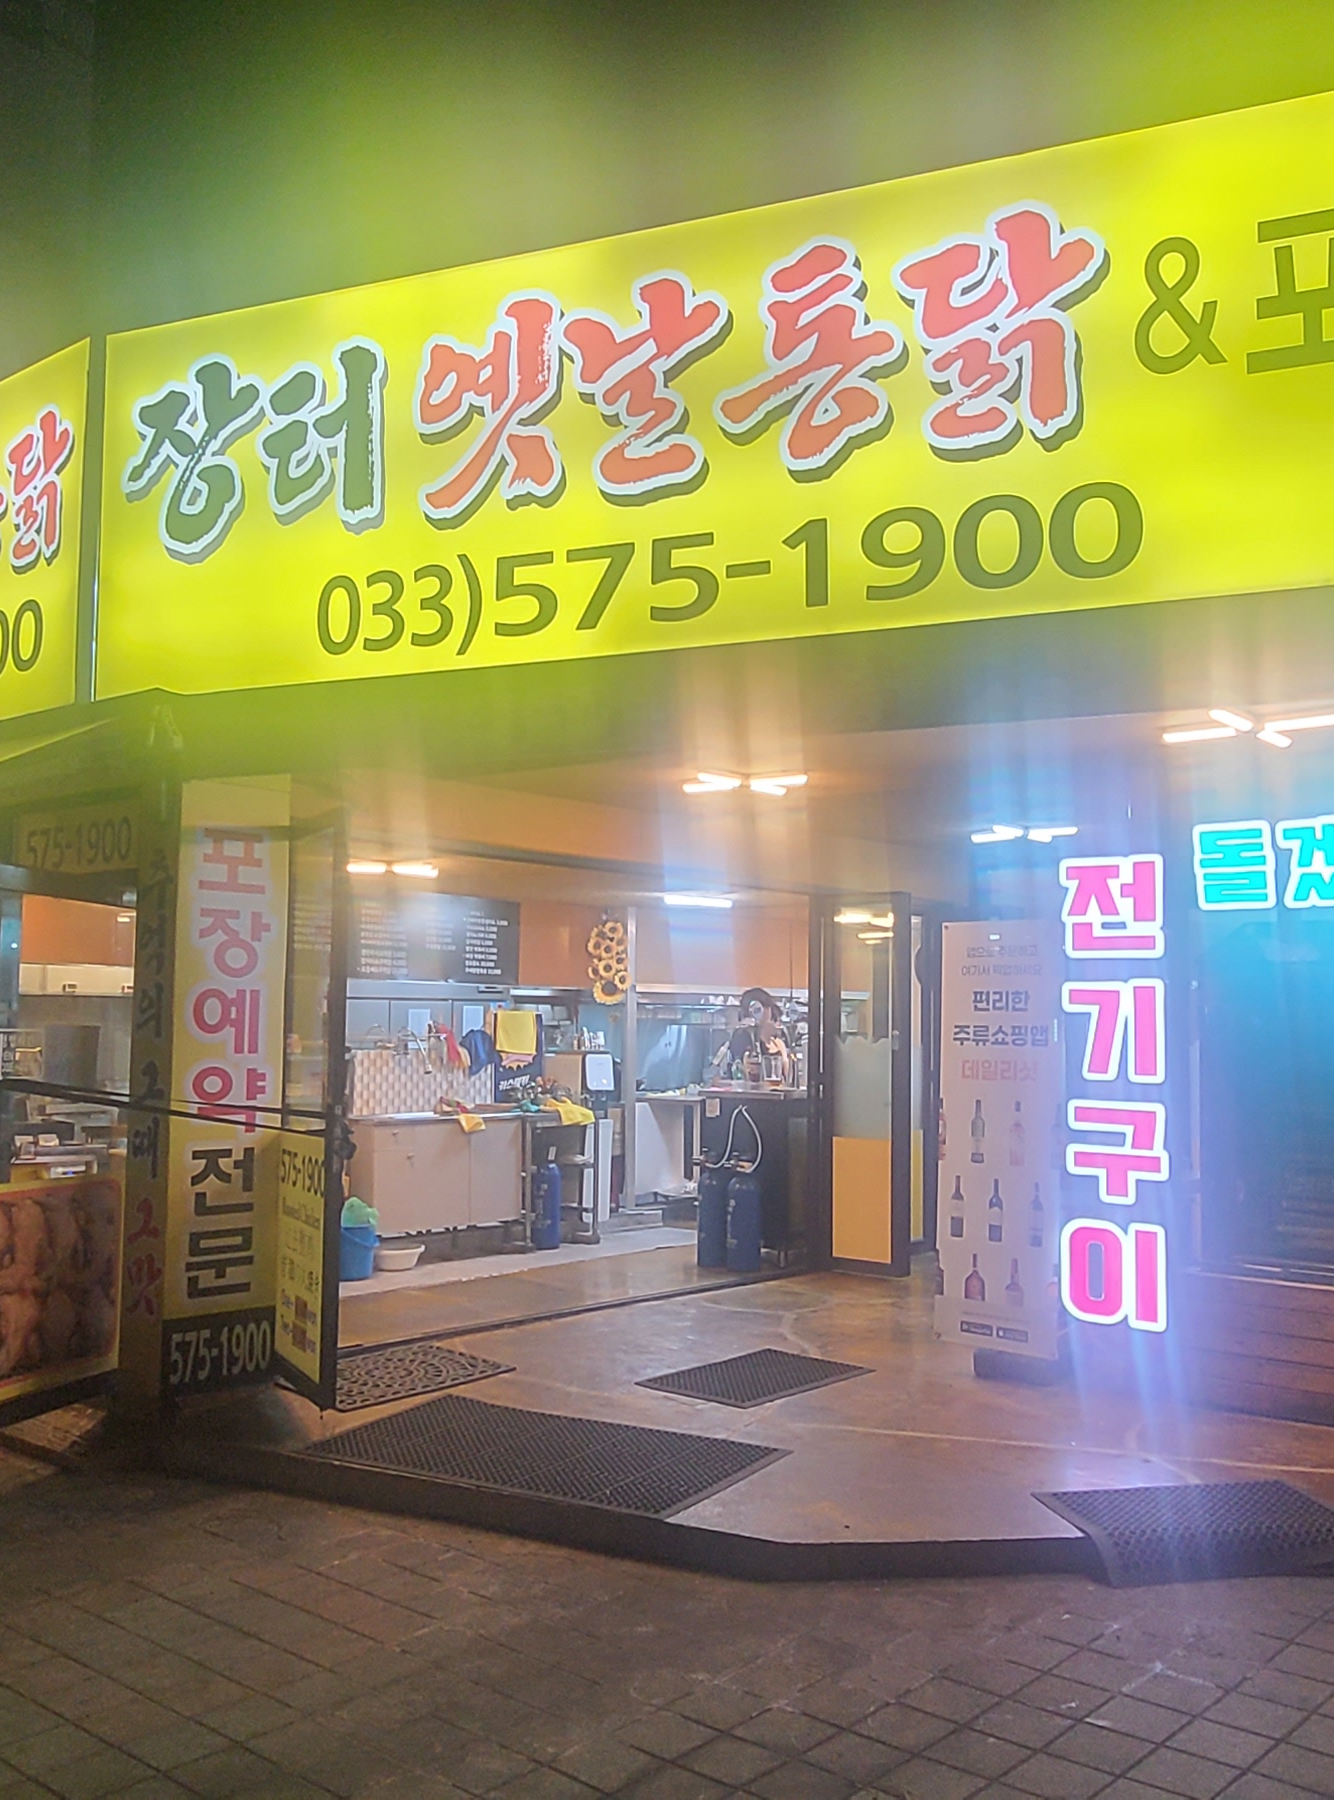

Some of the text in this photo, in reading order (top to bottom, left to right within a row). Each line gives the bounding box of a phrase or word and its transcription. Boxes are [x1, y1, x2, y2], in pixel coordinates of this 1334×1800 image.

[316, 480, 1144, 656] 033)575-1900
[26, 815, 134, 874] 575-1900
[953, 1024, 1050, 1047] 주류쇼핑앱
[972, 990, 1031, 1012] 편리한
[184, 827, 271, 1301] 포장예약 전문
[1060, 853, 1170, 1333] 전기구이
[169, 1318, 270, 1387] 575-1900
